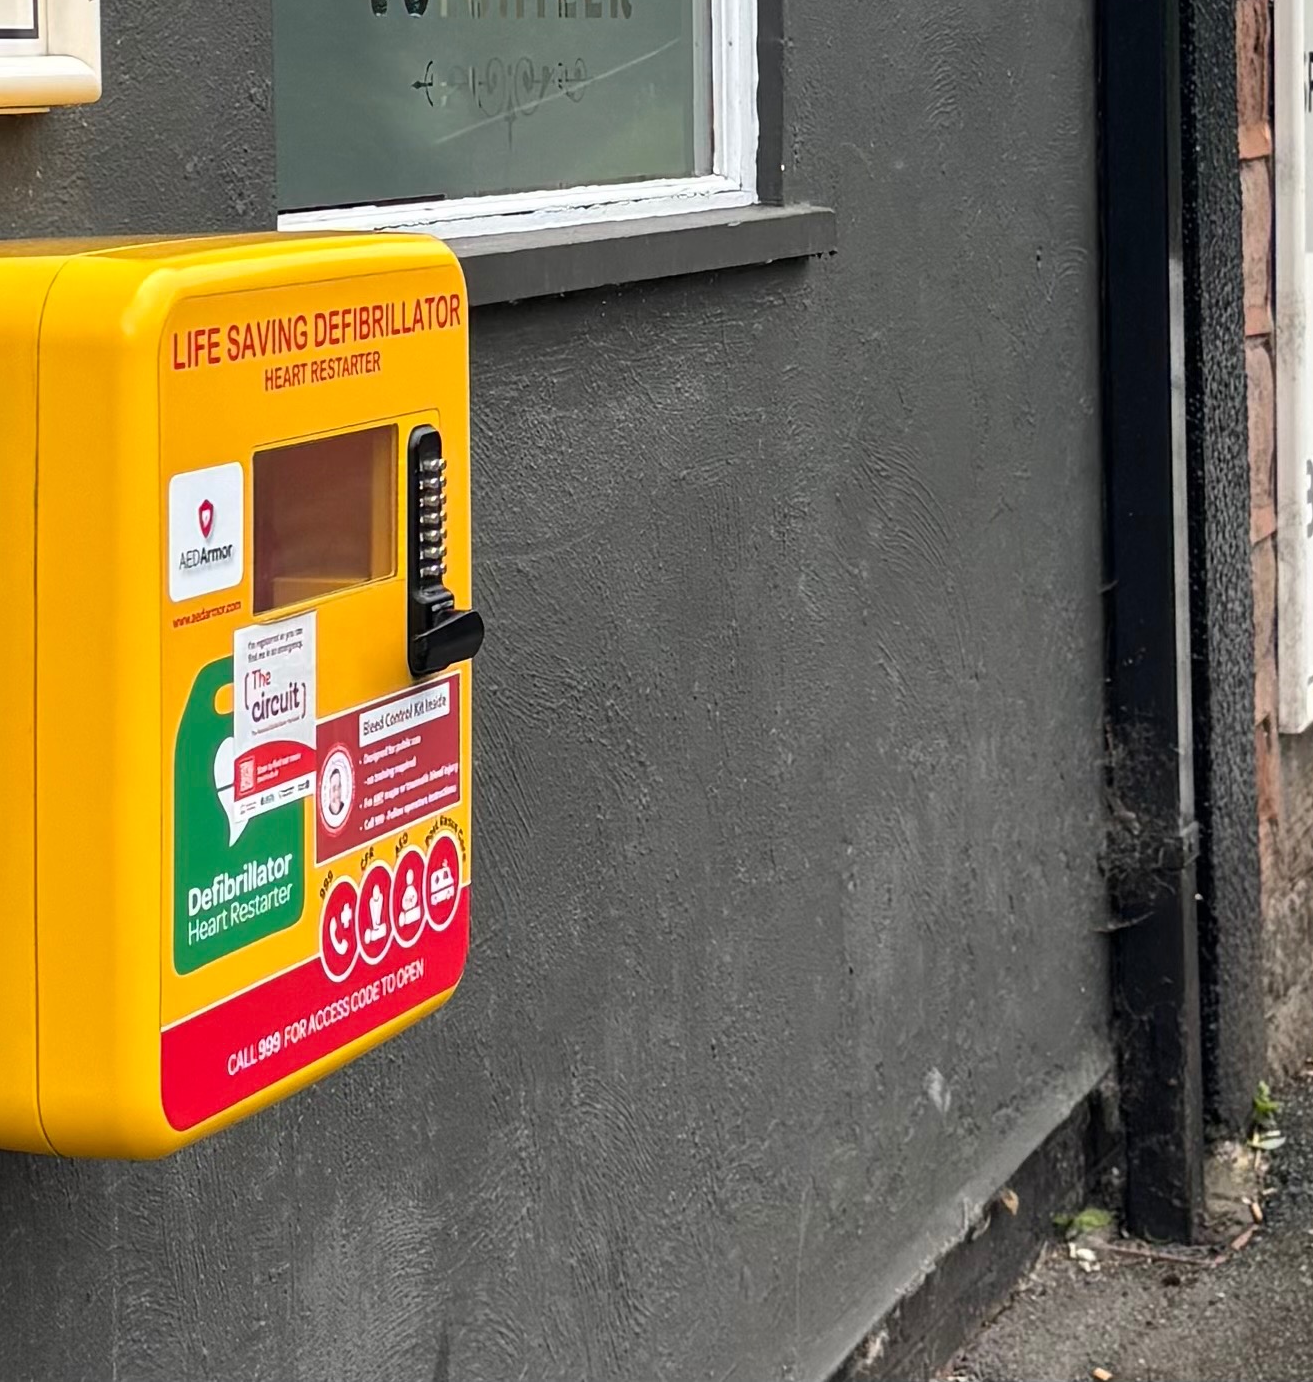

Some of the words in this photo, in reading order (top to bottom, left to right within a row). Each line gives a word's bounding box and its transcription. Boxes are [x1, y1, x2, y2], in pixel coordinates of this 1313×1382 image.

[173, 327, 221, 370] LIFE
[226, 313, 308, 362] SAVING
[313, 293, 462, 348] DEFIBRILLATOR
[265, 362, 309, 392] HEART
[310, 350, 381, 384] RESTARTER
[178, 544, 233, 571] AEDArmor
[251, 668, 272, 690] The
[251, 681, 301, 723] circuit
[385, 703, 413, 728] Control
[188, 853, 293, 917] Defibrillator
[188, 909, 228, 946] Heart
[230, 883, 293, 927] Restarter
[227, 1044, 258, 1076] CALL
[258, 1031, 281, 1061] 999
[283, 1018, 307, 1048] FOR
[307, 996, 351, 1036] ACCESS
[350, 981, 381, 1013] CODE
[381, 973, 397, 996] TO
[396, 957, 425, 989] OPEN
